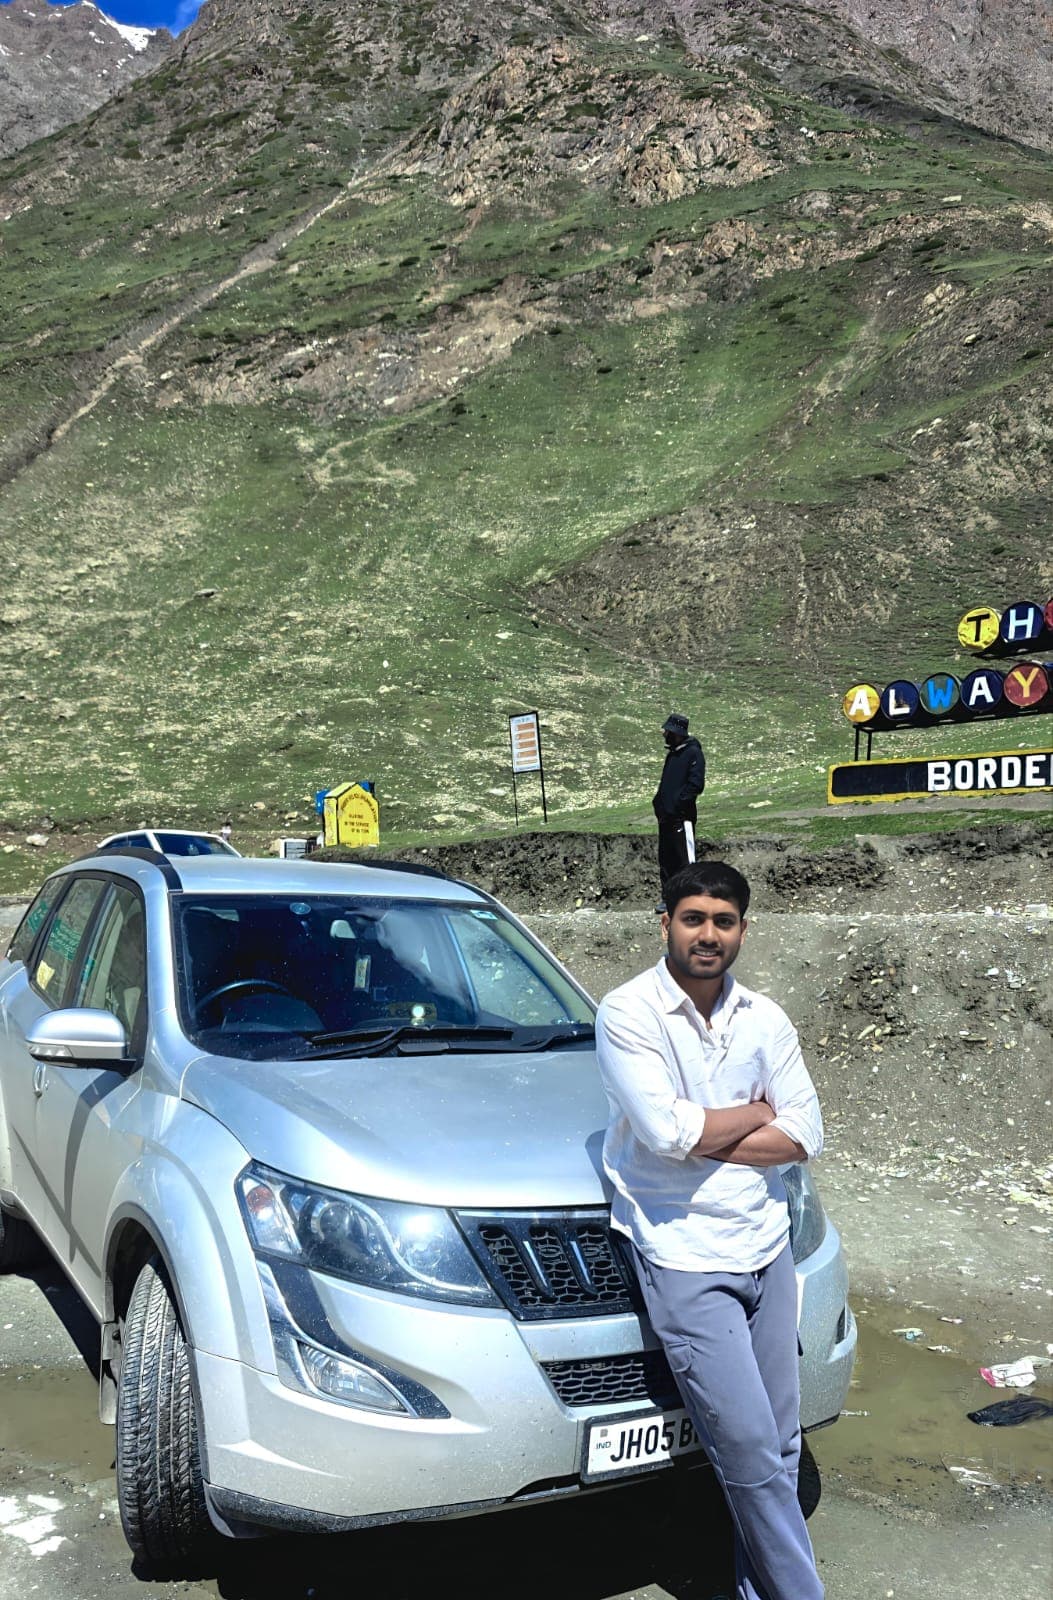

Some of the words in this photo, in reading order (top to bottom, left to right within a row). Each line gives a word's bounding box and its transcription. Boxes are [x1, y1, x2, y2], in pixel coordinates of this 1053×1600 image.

[966, 607, 1035, 642] TH
[927, 754, 1053, 792] BORDE
[595, 1441, 612, 1450] IND
[610, 1417, 701, 1462] JH05B
